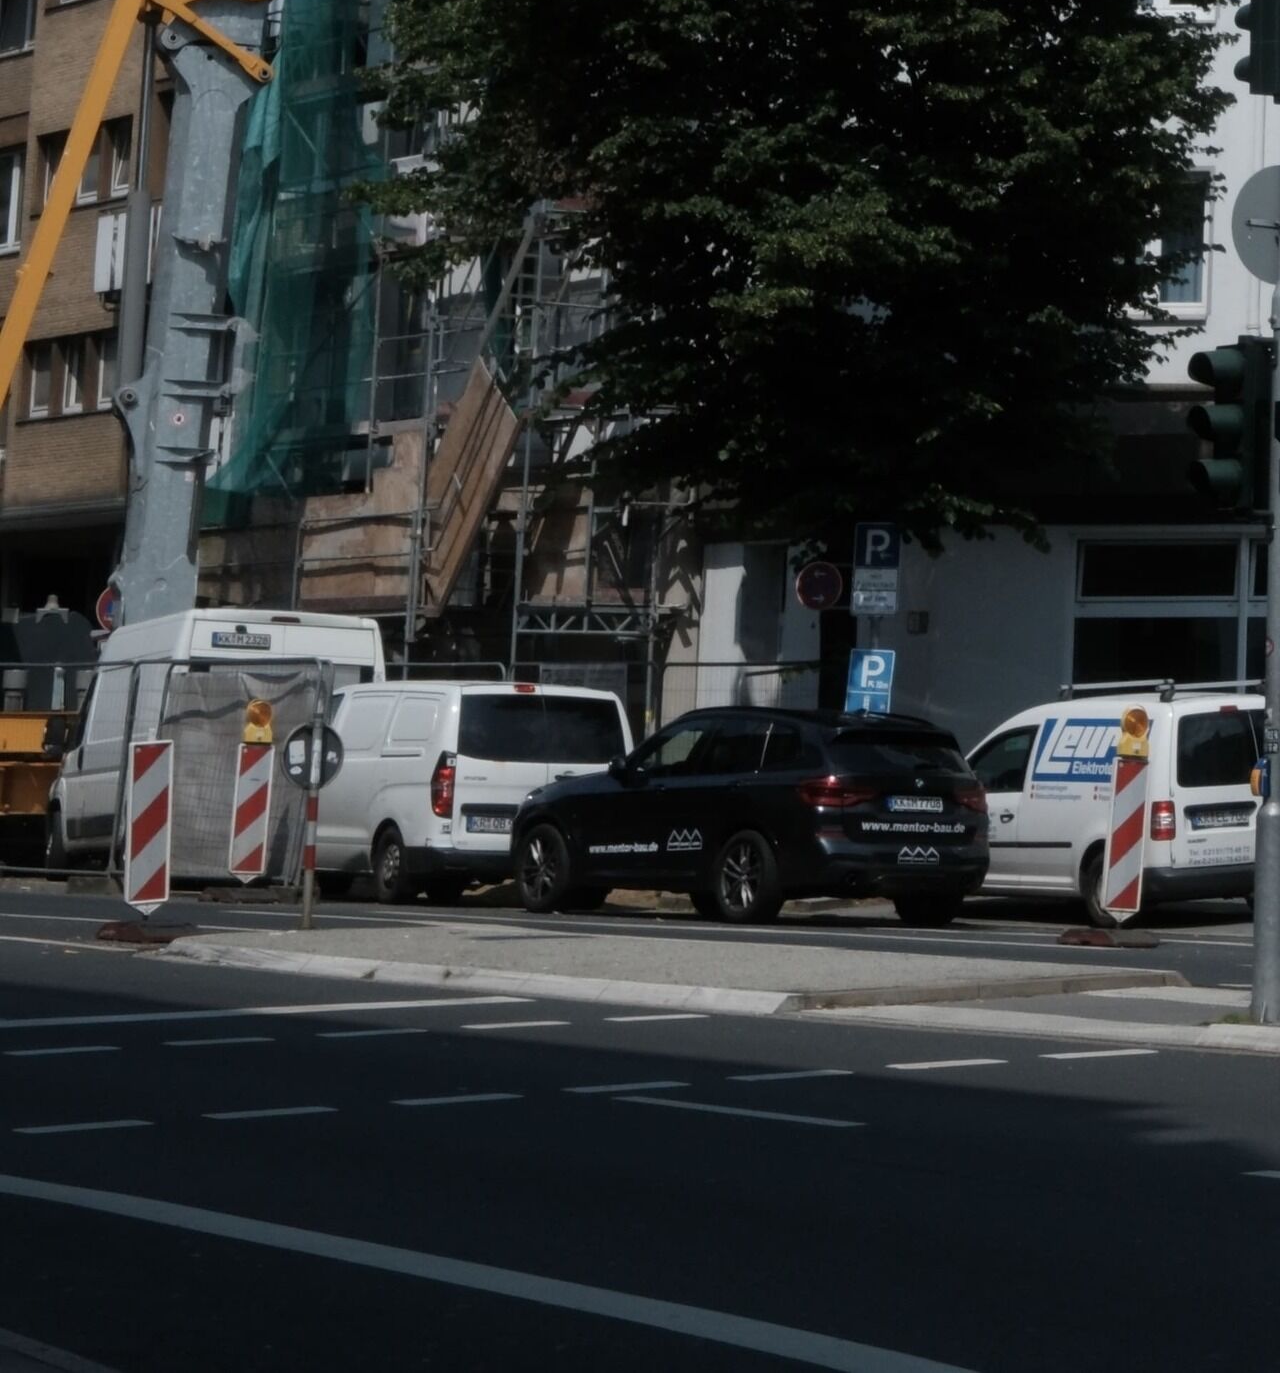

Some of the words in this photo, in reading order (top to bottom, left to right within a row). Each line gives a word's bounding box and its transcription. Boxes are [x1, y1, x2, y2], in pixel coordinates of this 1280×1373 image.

[865, 529, 890, 565] P
[861, 655, 886, 688] P
[861, 821, 966, 834] www.mentor-bau.de
